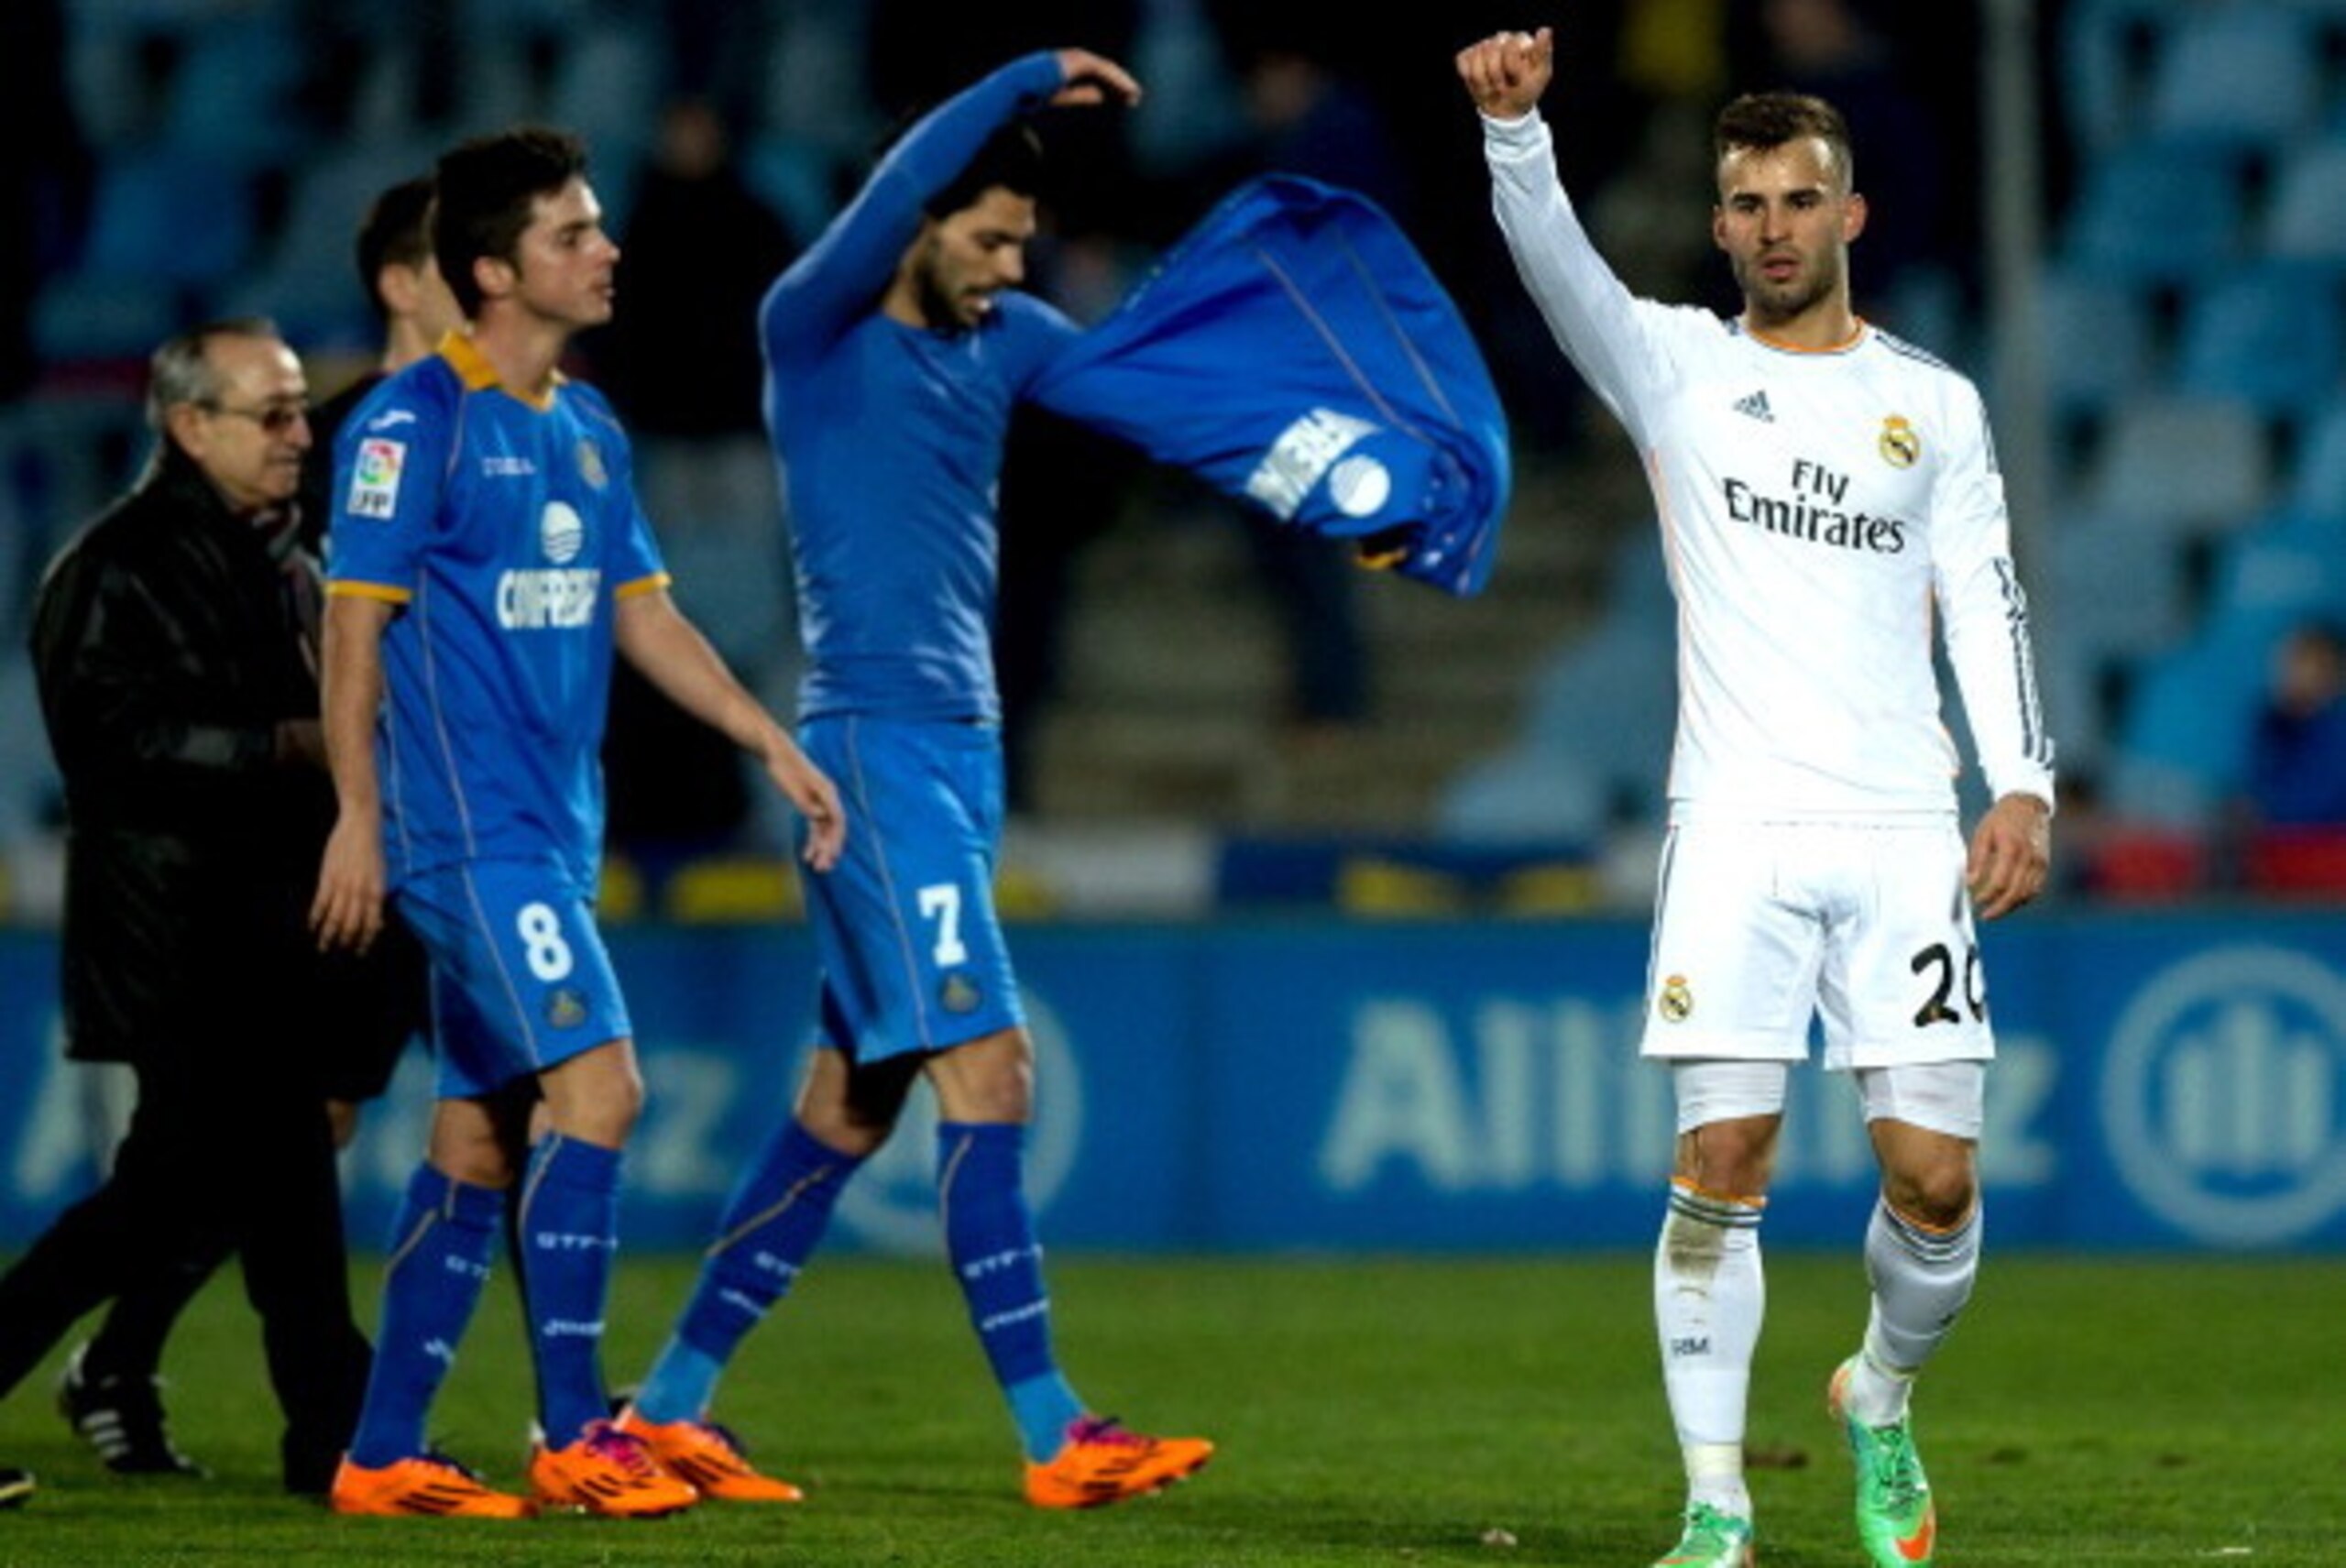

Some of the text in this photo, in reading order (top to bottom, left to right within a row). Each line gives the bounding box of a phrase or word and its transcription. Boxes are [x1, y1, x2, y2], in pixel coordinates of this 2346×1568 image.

[1723, 477, 1905, 554] Emirates
[1792, 458, 1849, 505] Fly
[518, 902, 573, 981] 8
[919, 883, 967, 967] 7
[1320, 999, 2056, 1190] Alliz
